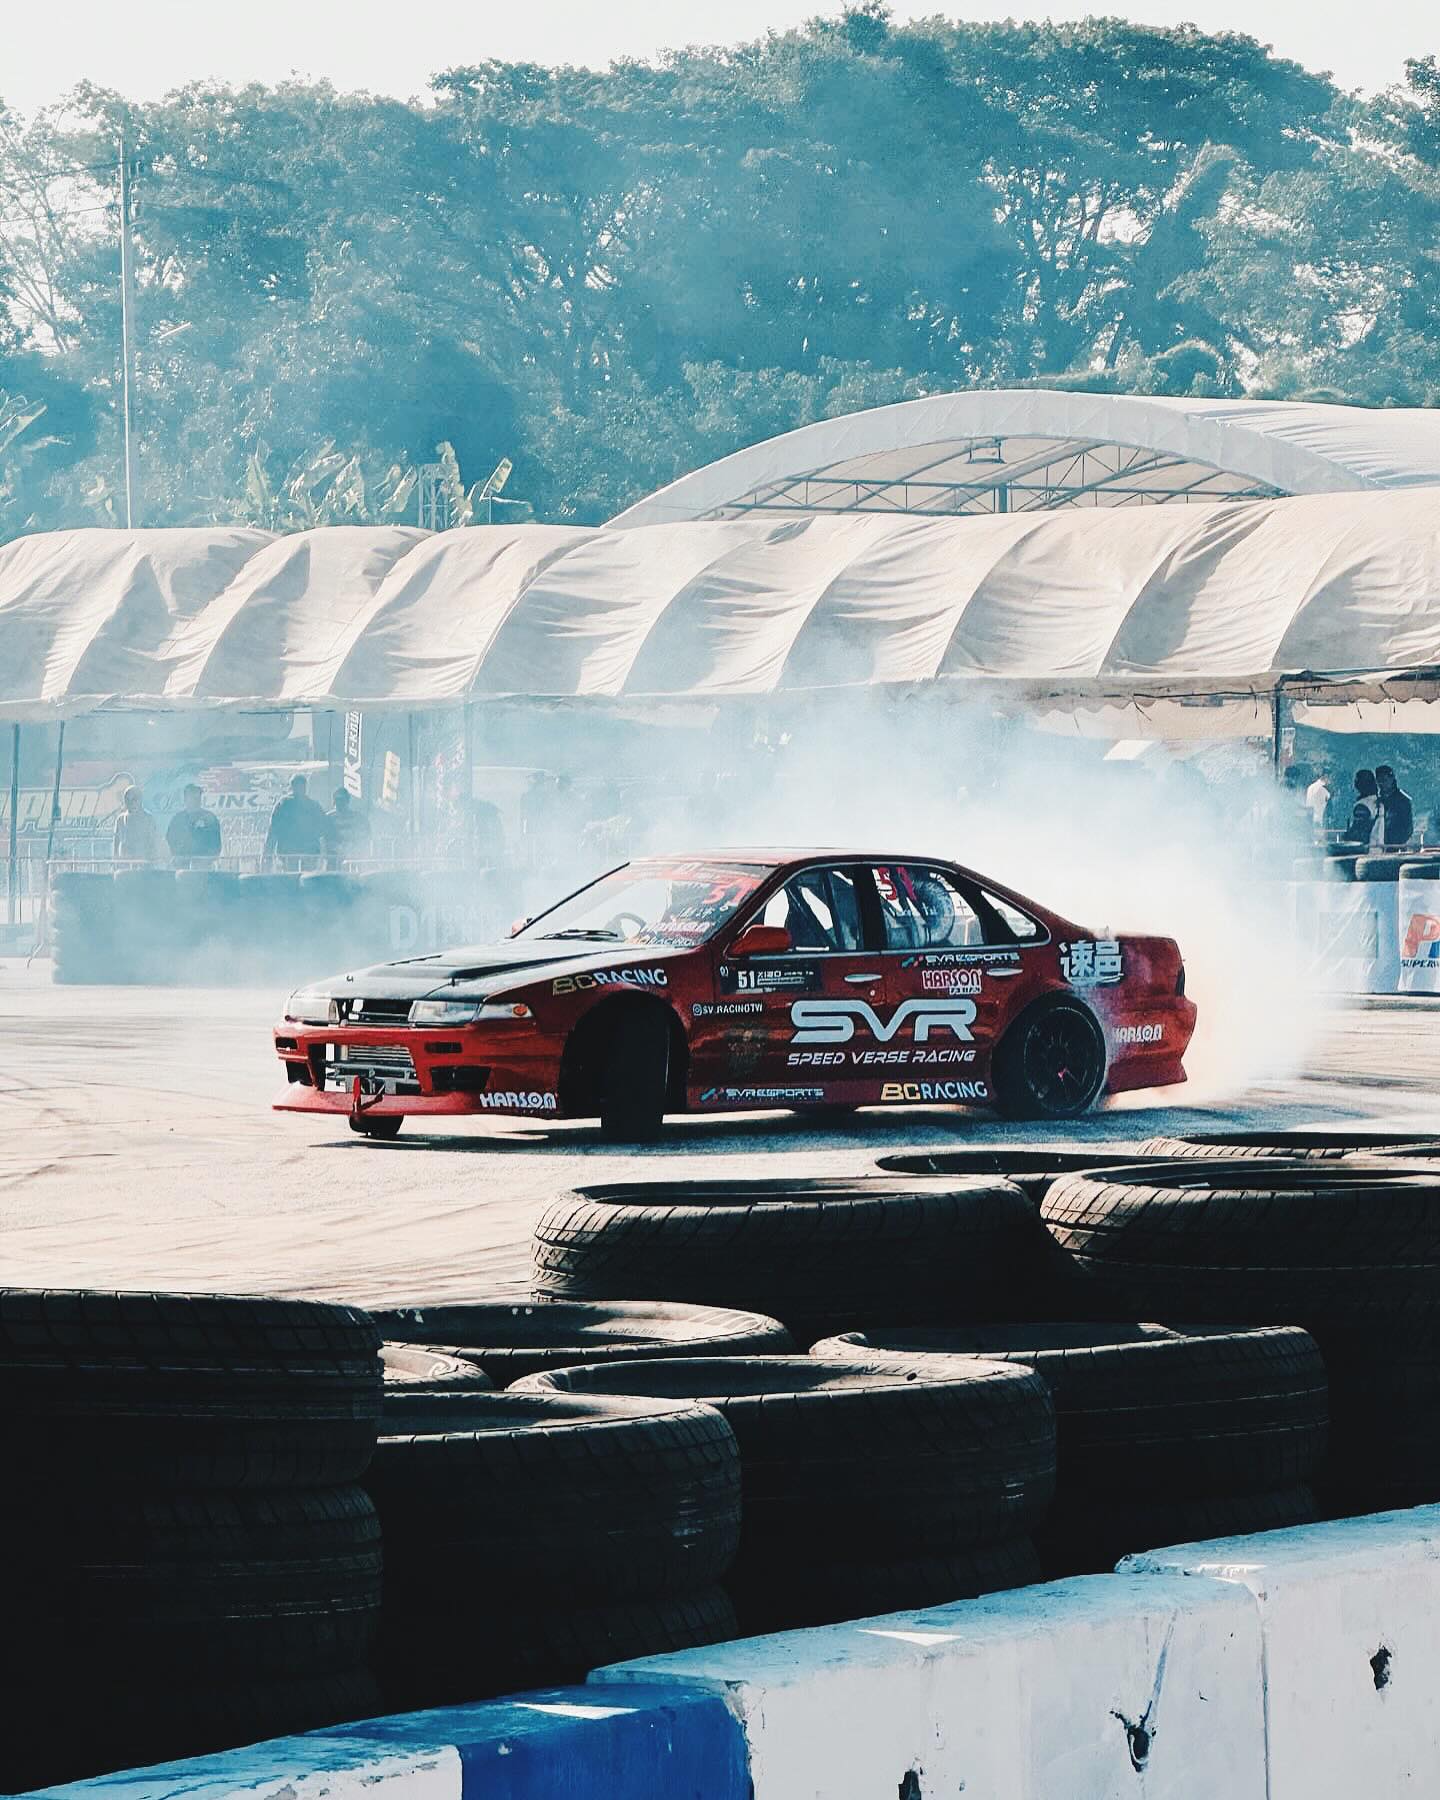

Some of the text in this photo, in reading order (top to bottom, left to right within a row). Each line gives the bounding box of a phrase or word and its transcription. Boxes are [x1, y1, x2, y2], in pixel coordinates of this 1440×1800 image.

[738, 970, 755, 988] 51
[791, 999, 977, 1043] SVR
[787, 1050, 976, 1066] SPEED VERSE RACING
[480, 1092, 557, 1109] HARSON
